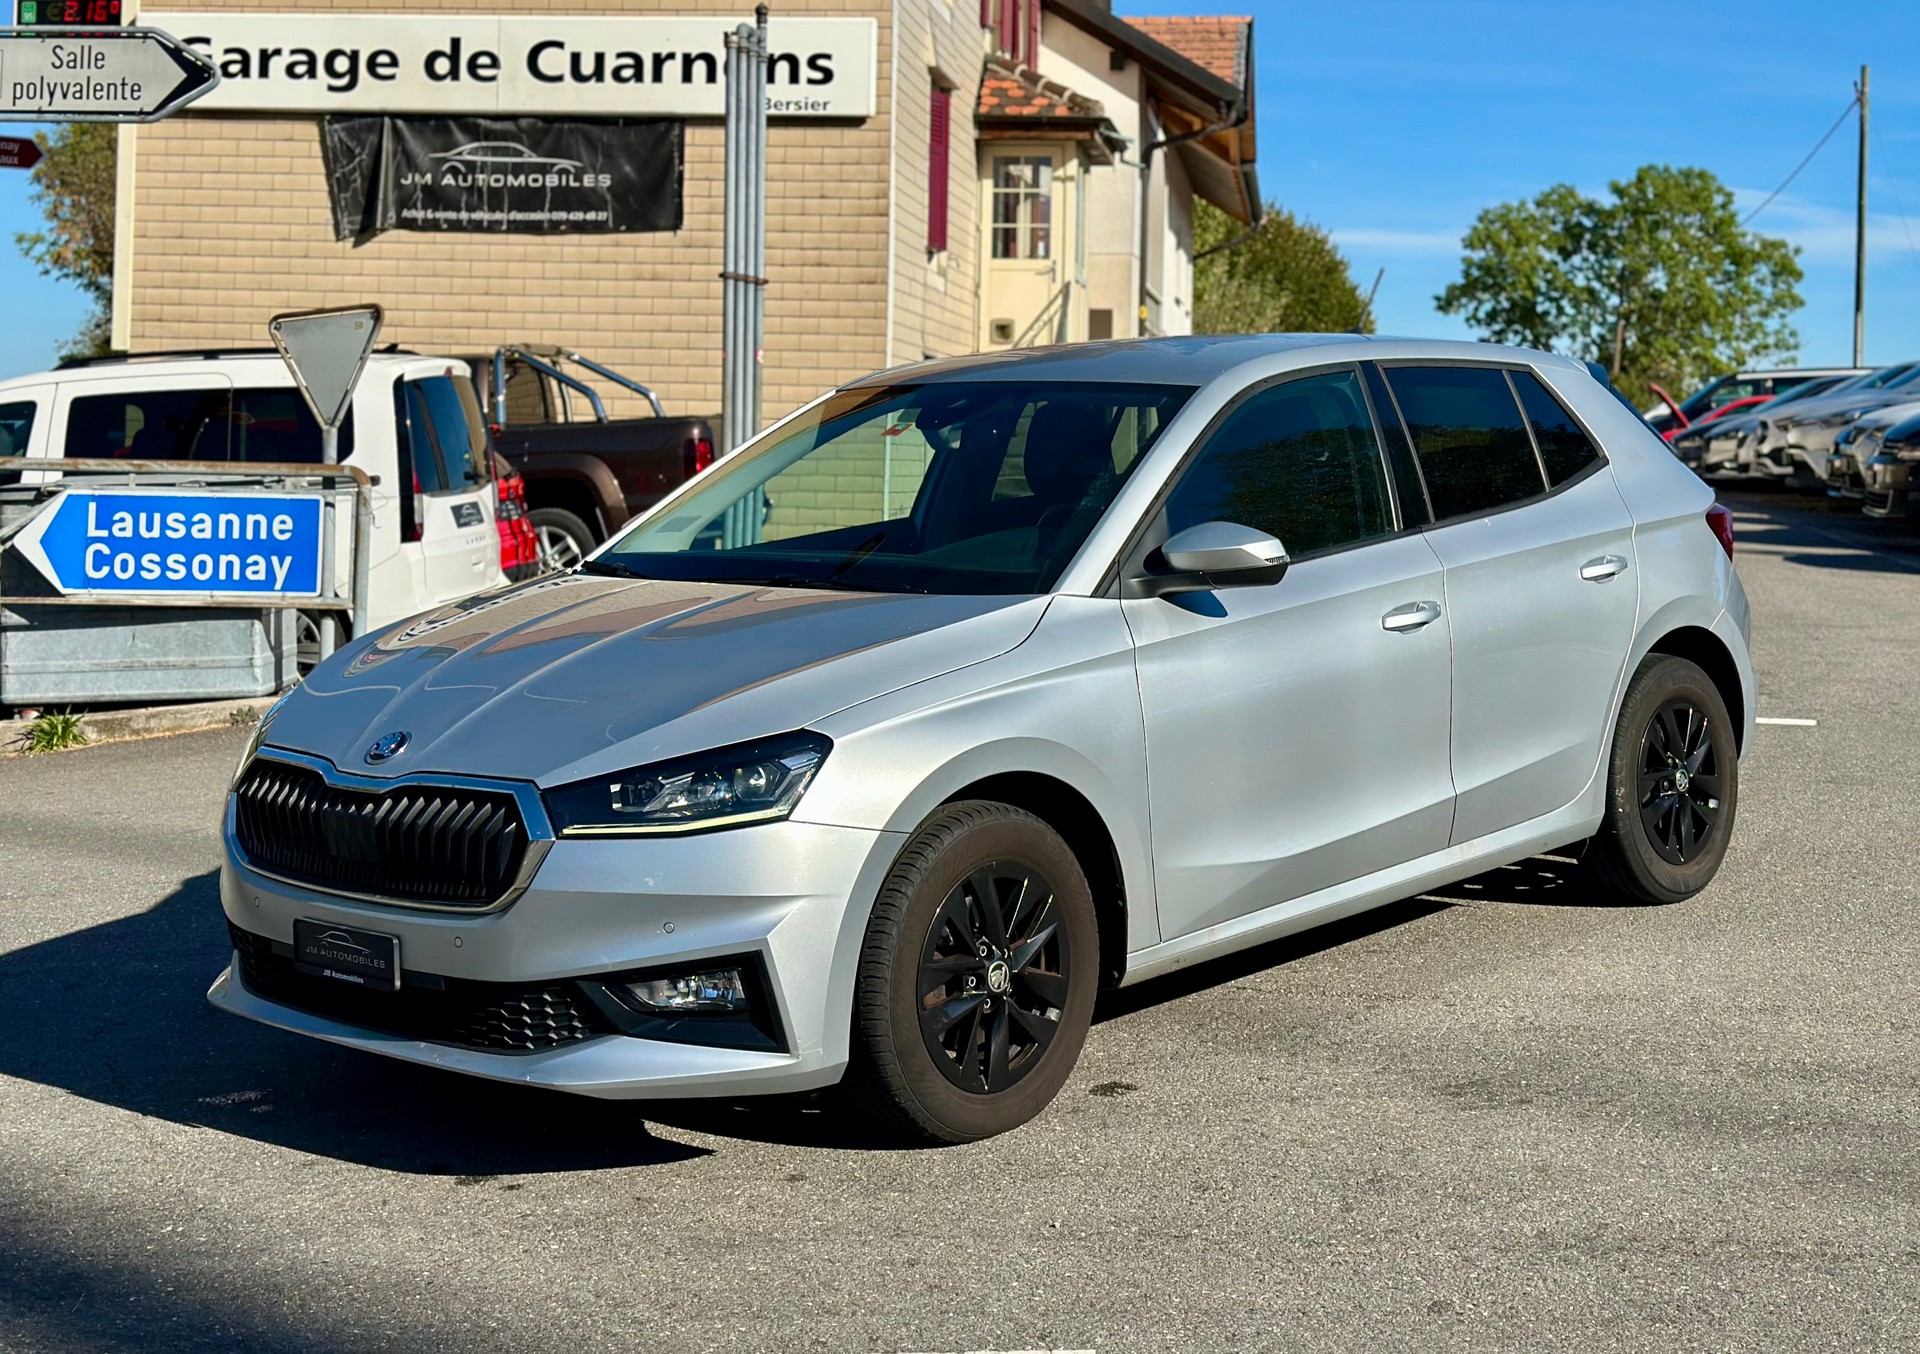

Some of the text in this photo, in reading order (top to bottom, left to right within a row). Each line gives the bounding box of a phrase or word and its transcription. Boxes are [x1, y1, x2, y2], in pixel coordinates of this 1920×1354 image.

[51, 44, 106, 70] Salle
[424, 37, 502, 83] de
[526, 39, 835, 86] Cuarnns
[12, 75, 142, 106] polyvalente
[0, 141, 20, 154] nay
[400, 173, 612, 188] JM AUTOMOBILES
[86, 501, 294, 541] Lausanne
[85, 542, 293, 590] Cossonay
[305, 945, 386, 969] JM AUTOMOBILES
[332, 970, 364, 984] Automobiles
